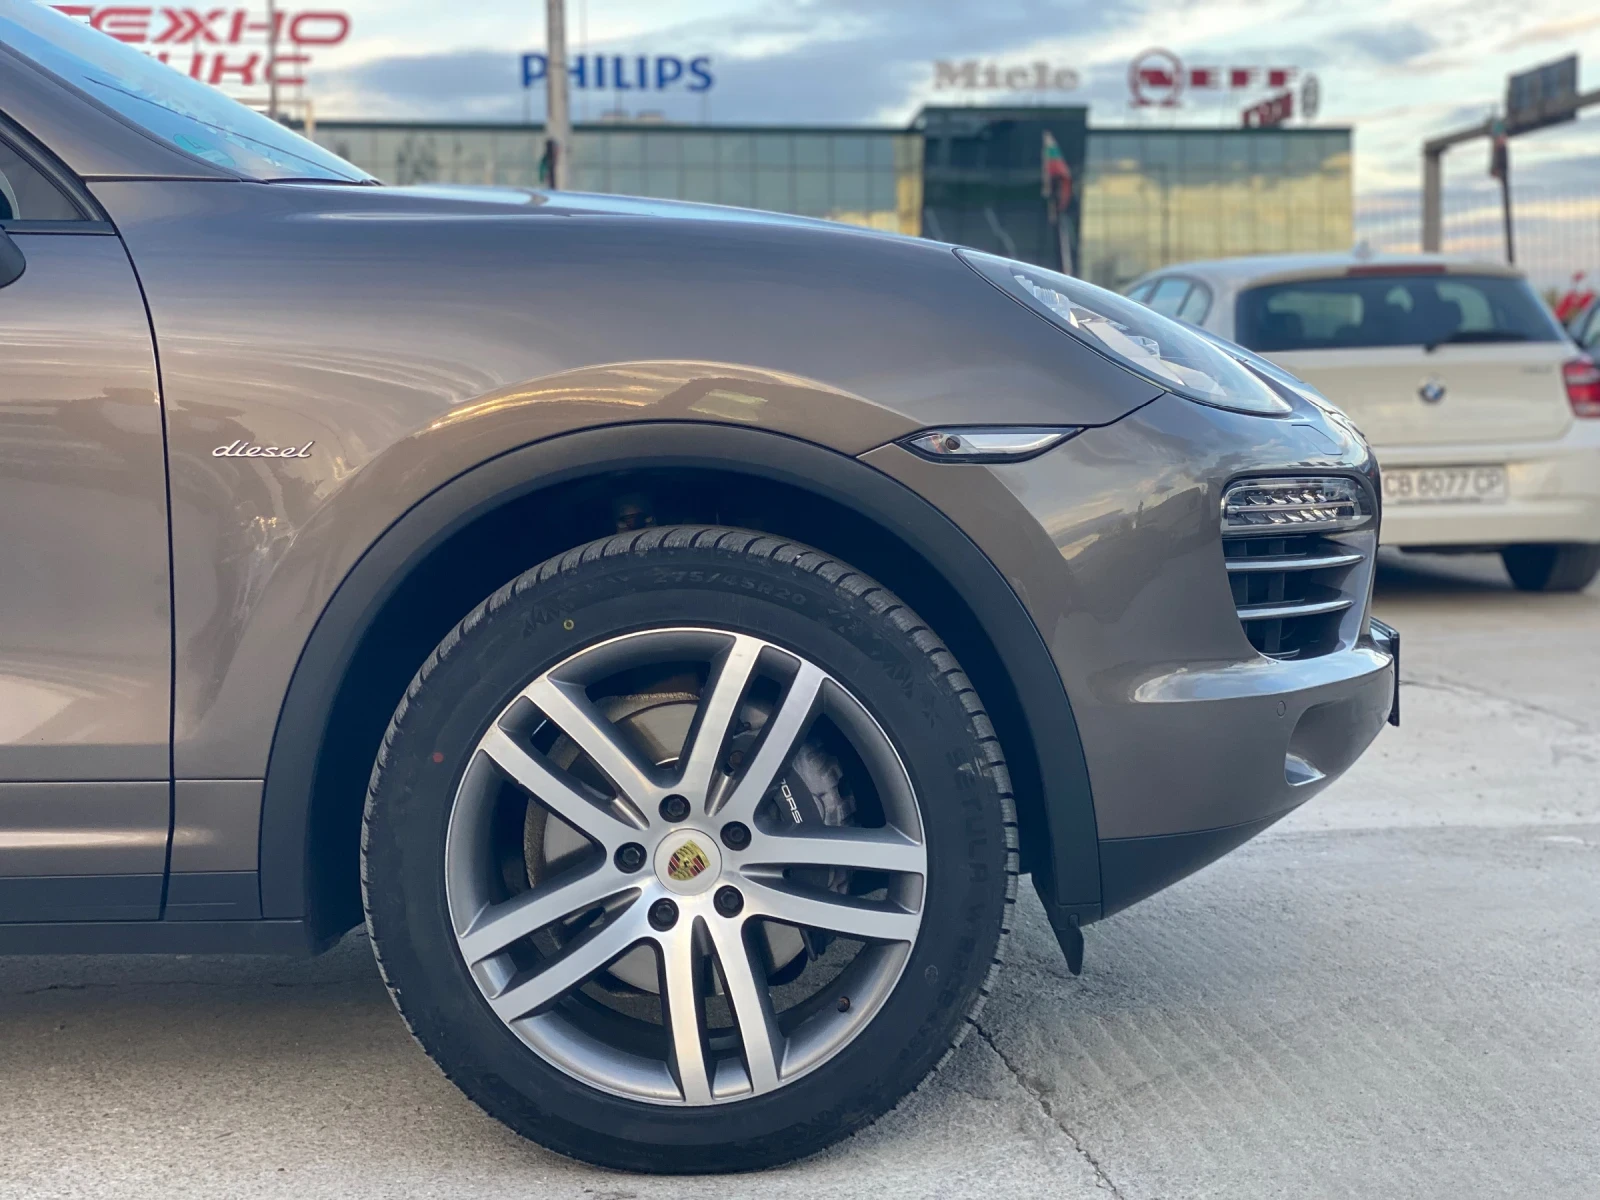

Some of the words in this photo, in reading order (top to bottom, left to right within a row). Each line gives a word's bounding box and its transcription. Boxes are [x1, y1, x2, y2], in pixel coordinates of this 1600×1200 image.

[521, 53, 714, 91] PHILIPS
[934, 60, 1079, 91] Miele
[212, 439, 315, 458] diesel
